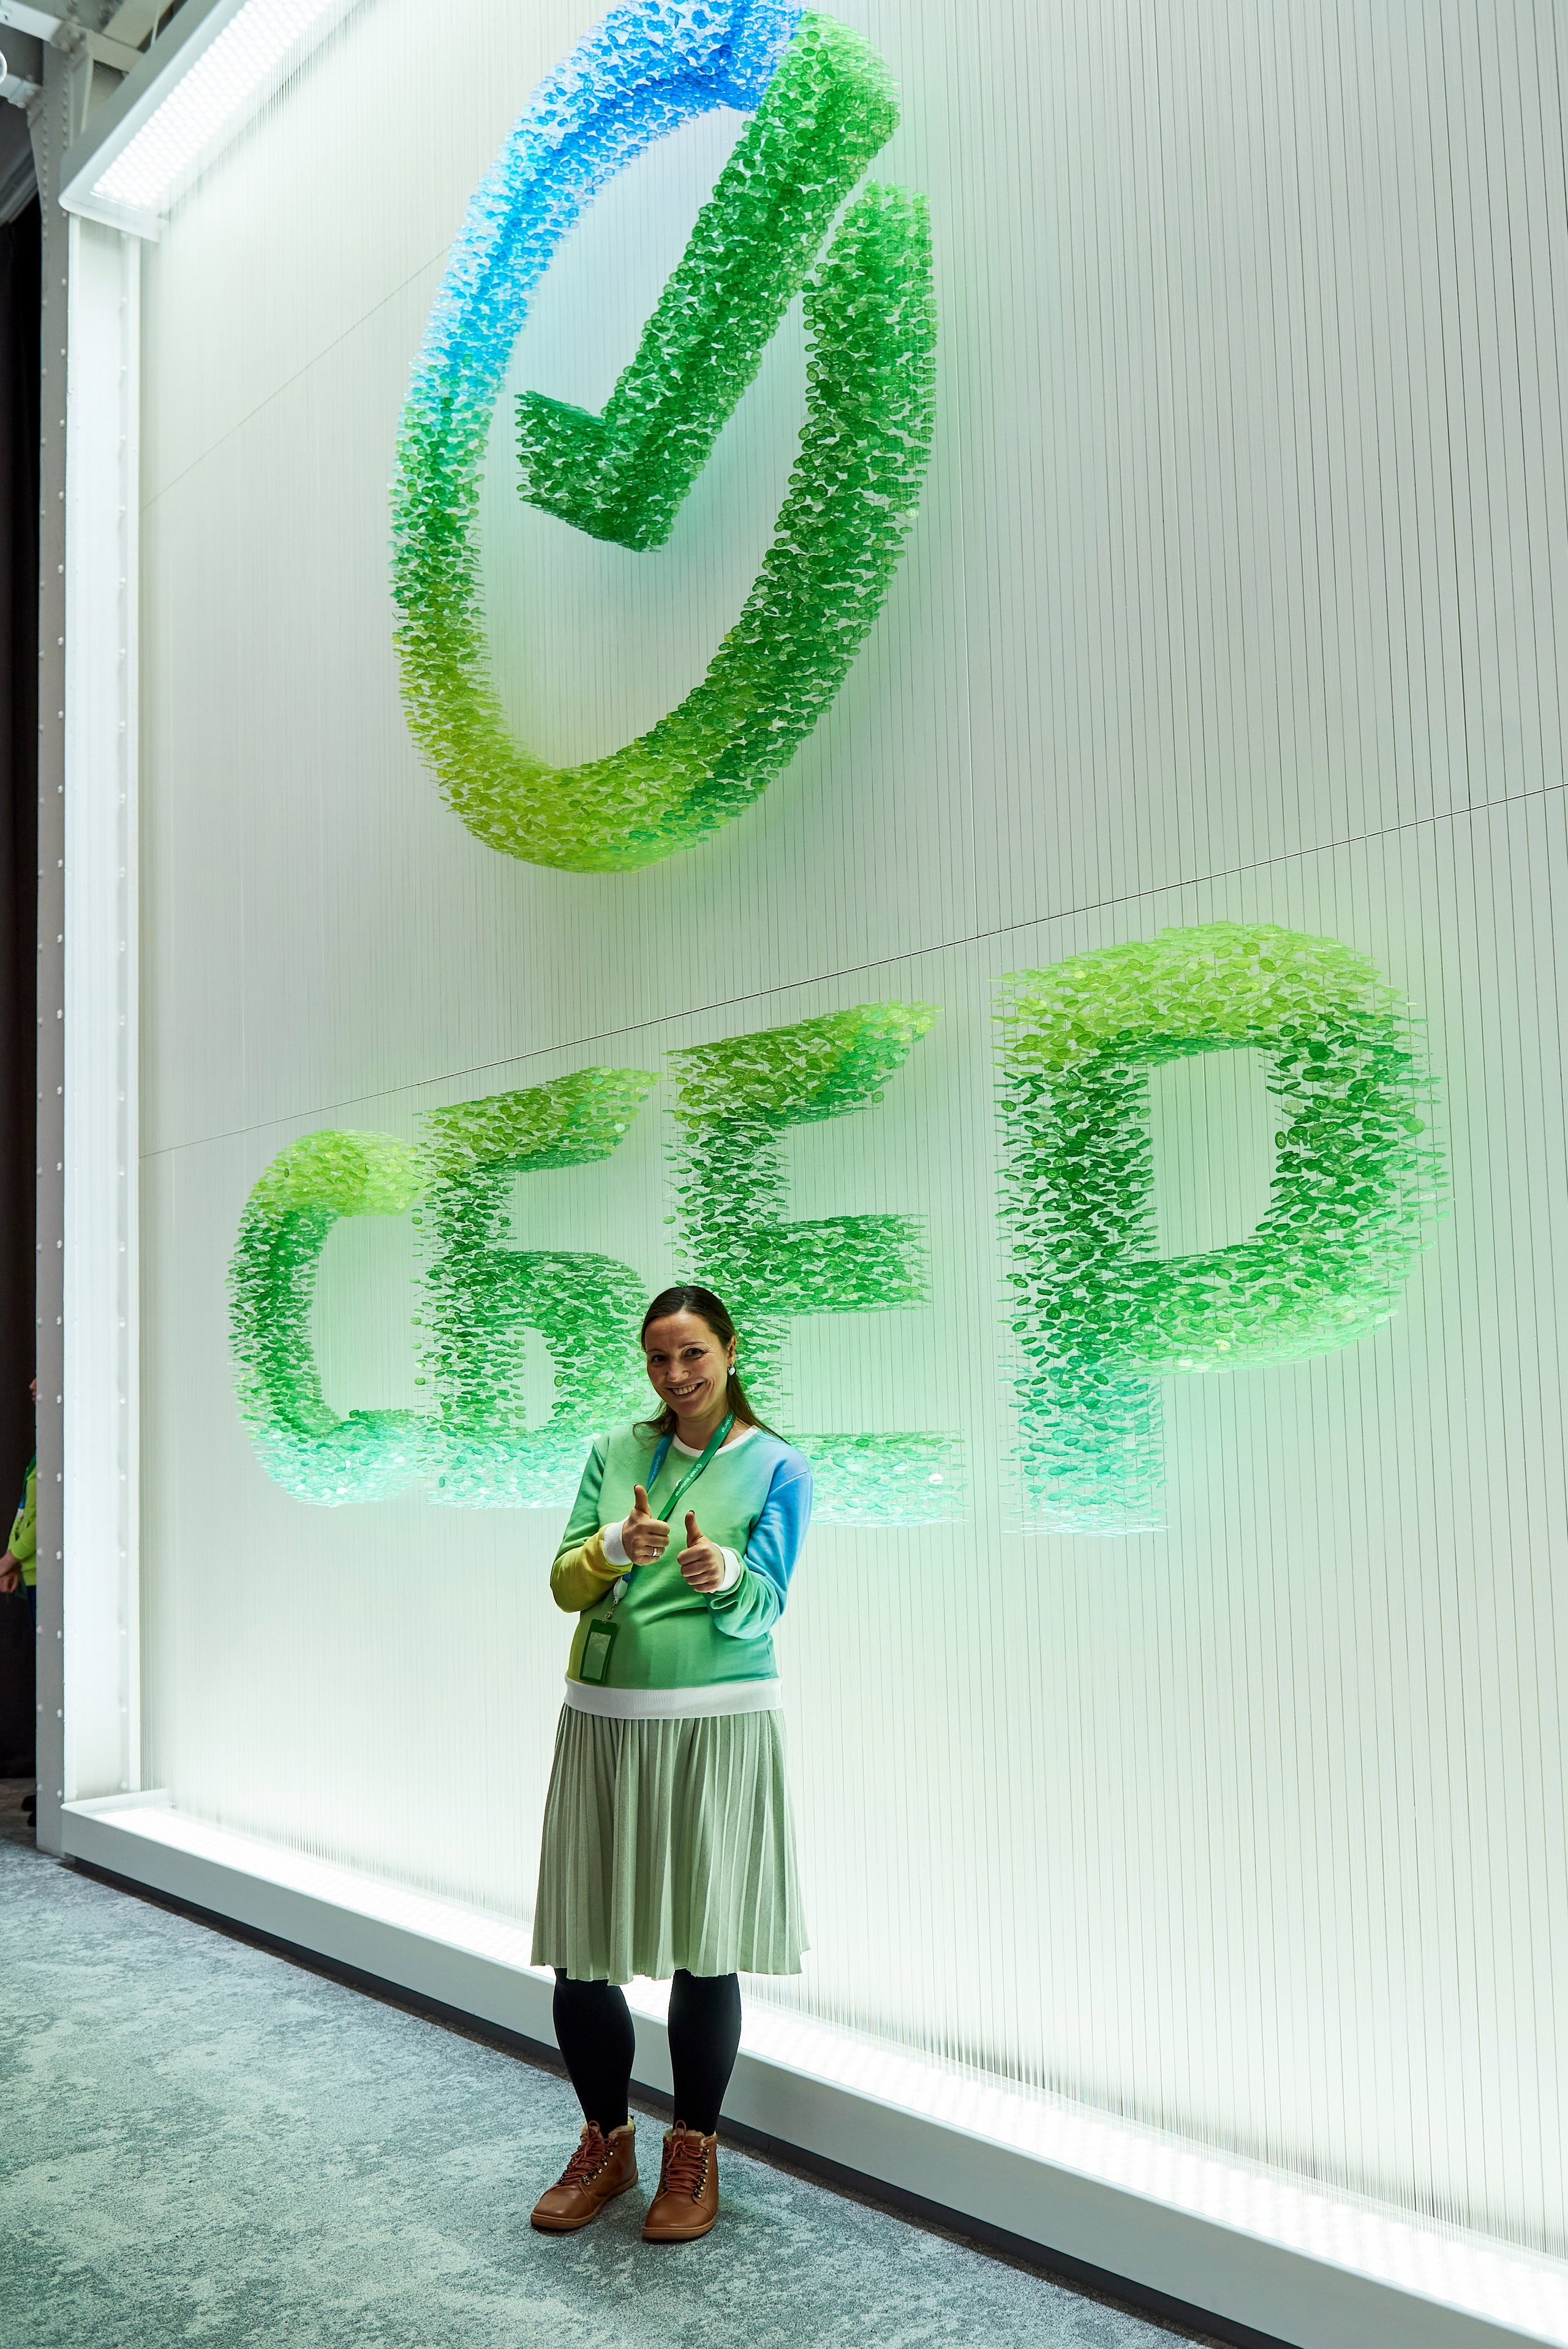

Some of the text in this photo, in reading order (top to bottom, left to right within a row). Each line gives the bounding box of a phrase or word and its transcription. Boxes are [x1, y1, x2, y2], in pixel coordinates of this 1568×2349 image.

[227, 922, 1452, 1536] СБЕР
[675, 1468, 698, 1496] СБЕР ВОЛОНТЕР
